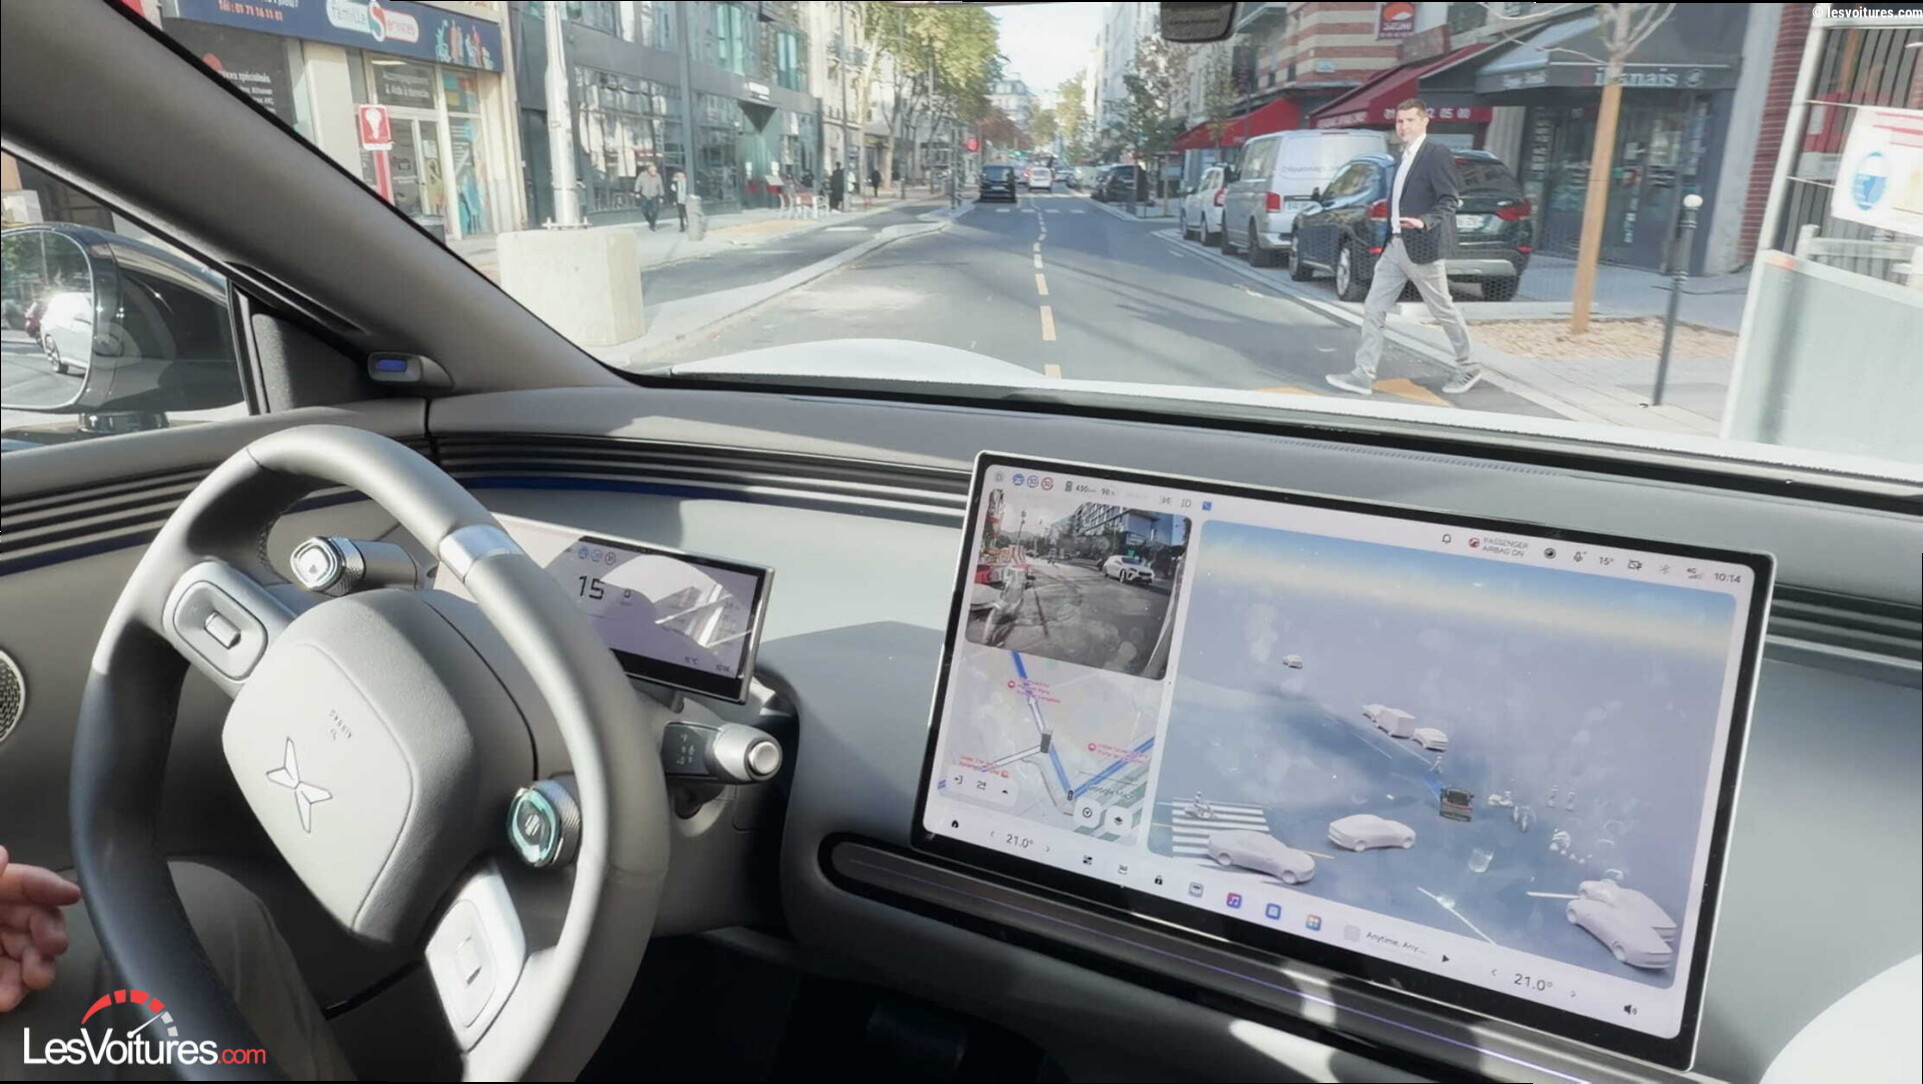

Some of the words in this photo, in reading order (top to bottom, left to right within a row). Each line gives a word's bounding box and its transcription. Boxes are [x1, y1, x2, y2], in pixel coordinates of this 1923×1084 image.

[1483, 537, 1529, 549] PASSENGER
[1713, 572, 1742, 584] 10:14
[579, 575, 605, 600] 15
[1006, 833, 1034, 848] 21.0°
[1513, 973, 1553, 991] 21.0°
